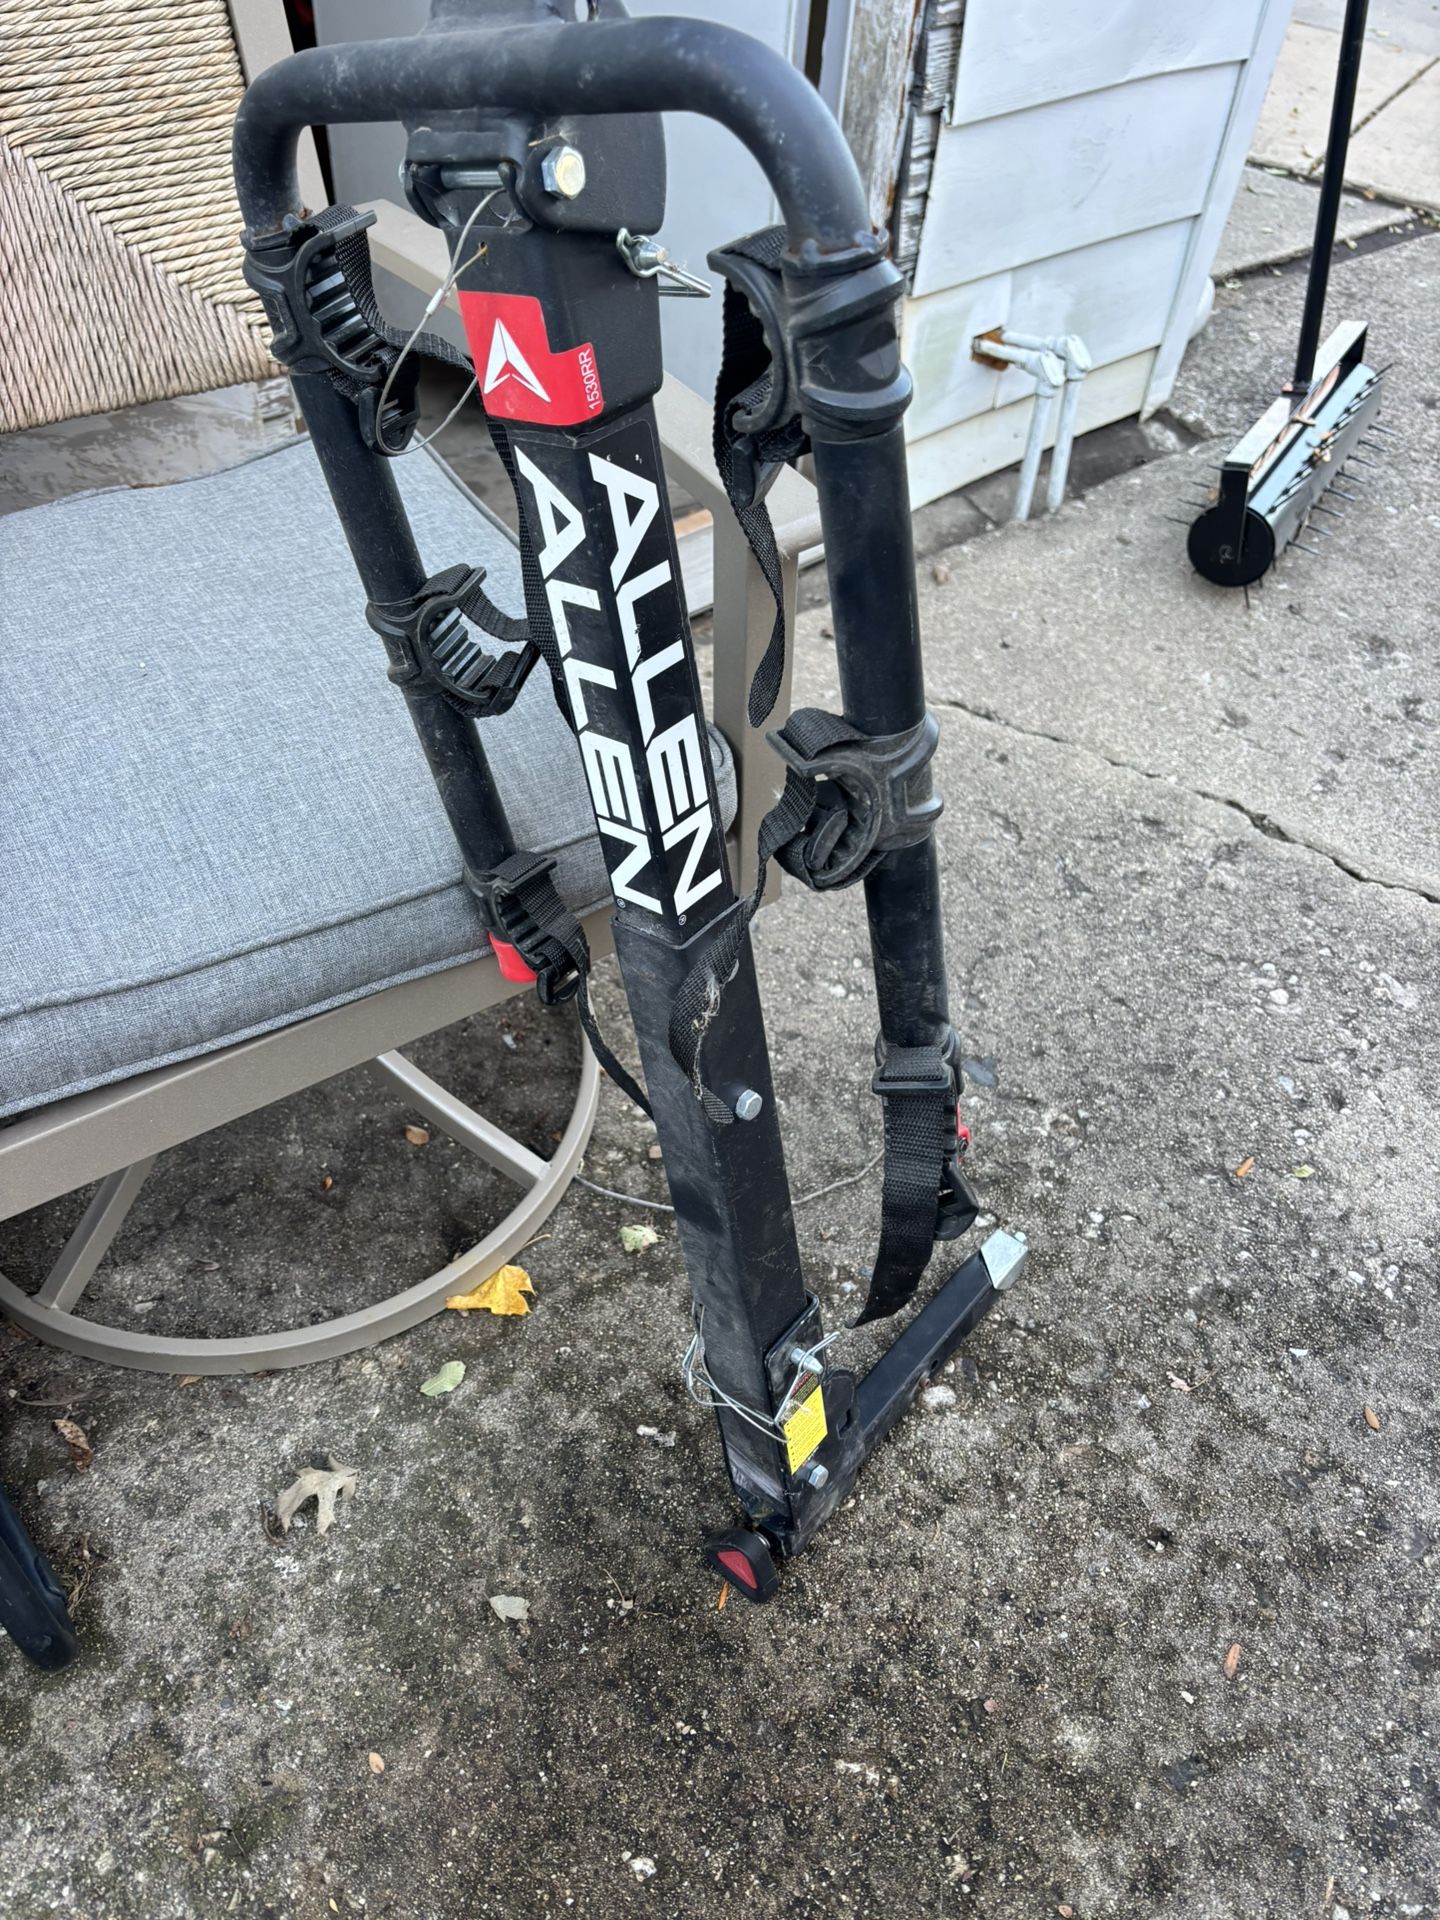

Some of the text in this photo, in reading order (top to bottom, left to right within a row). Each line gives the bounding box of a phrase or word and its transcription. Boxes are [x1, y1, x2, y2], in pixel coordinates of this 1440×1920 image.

[578, 348, 601, 409] 1530RR
[514, 445, 663, 915] ALLEN
[588, 452, 722, 916] ALLEN
